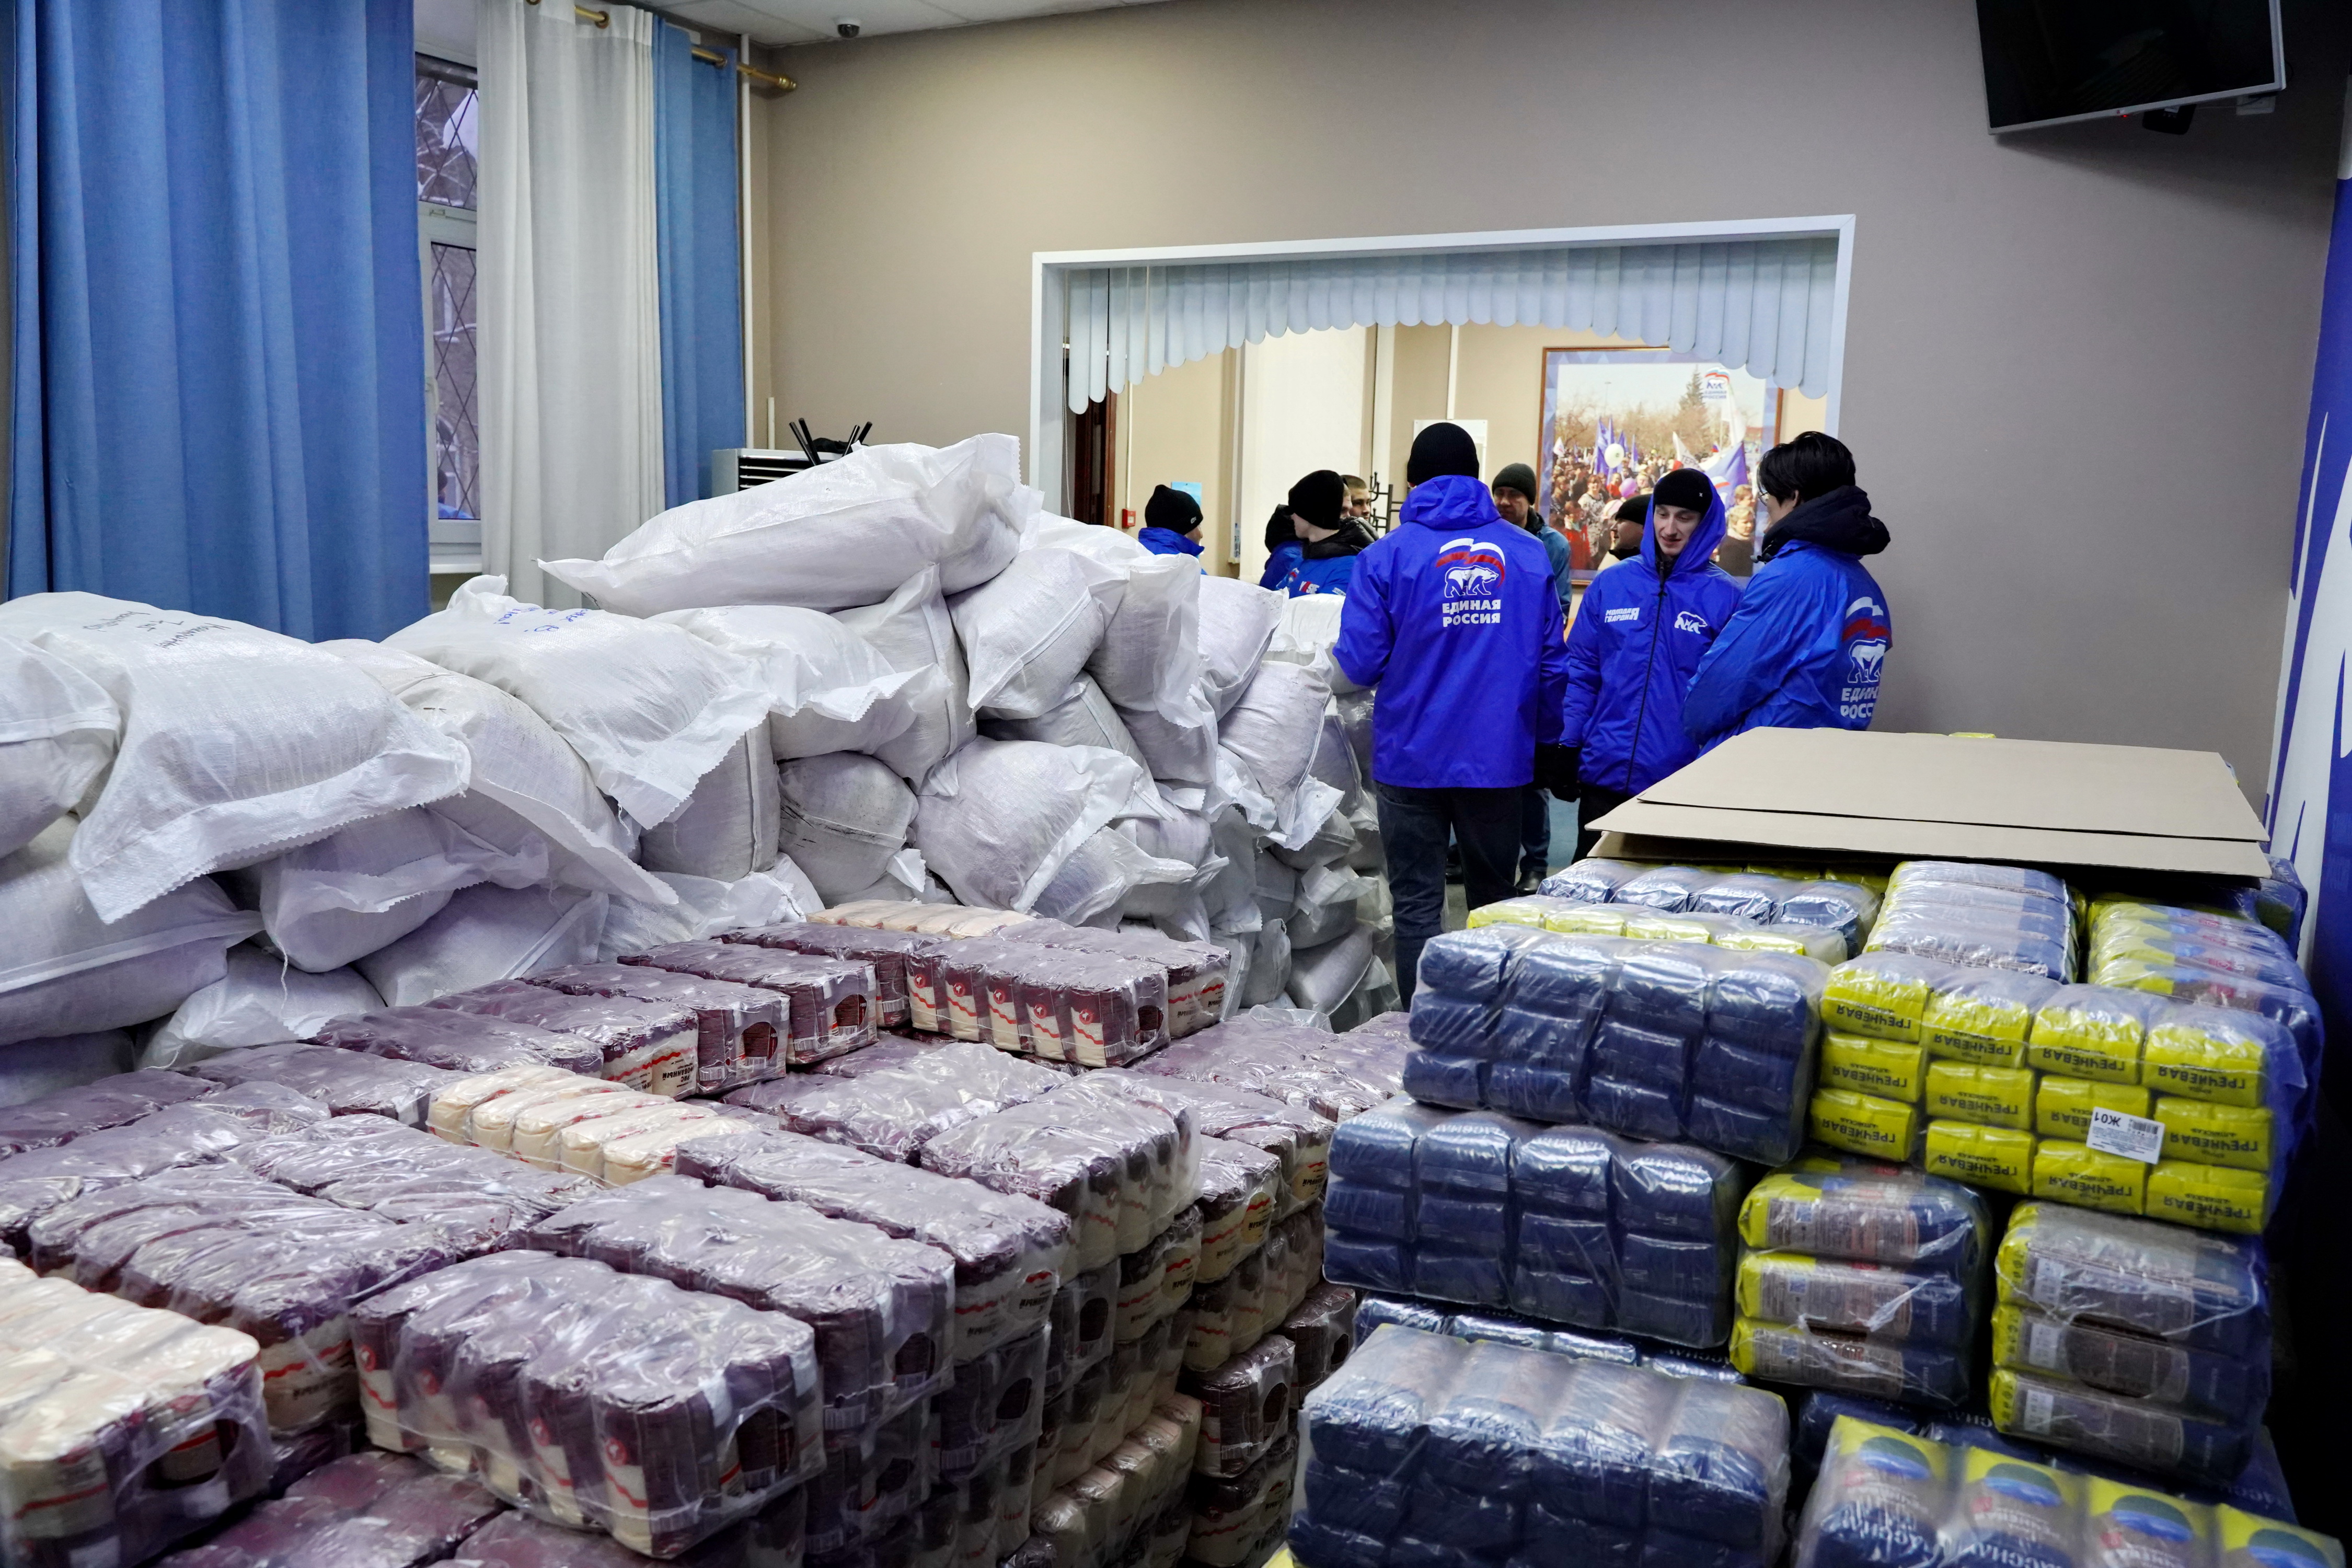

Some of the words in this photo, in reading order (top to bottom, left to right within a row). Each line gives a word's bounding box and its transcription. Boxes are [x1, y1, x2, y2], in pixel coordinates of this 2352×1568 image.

[1443, 599, 1501, 615] ЕДИНАЯ
[1606, 607, 1640, 617] МОЛОДАЯ
[1443, 613, 1501, 627] РОССИЯ
[1605, 613, 1640, 623] ГВАРДИЯ
[1841, 687, 1878, 702] ЕДИН
[1840, 702, 1874, 719] РОСС
[1836, 1005, 1911, 1029] ГРЕЧНЕВАЯ
[1934, 1034, 2012, 1056] ГРЕЧНЕВАЯ
[2043, 1048, 2125, 1071] ГРЕЧНЕВАЯ
[662, 1066, 694, 1081] ФОВАННЫЙ
[1832, 1066, 1908, 1088] ГРЕЧНЕВАЯ
[2158, 1067, 2245, 1089] ГРЕЧНЕВАЯ
[1940, 1096, 2018, 1114] ГРЕЧНЕВАЯ
[2094, 1111, 2121, 1128] Ж01
[1820, 1119, 1895, 1143] ГРЕЧНЕВАЯ
[2170, 1133, 2258, 1151] ГРЕЧНЕВАЯ
[1938, 1155, 2018, 1178] ГРЕЧНЕВАЯ
[2048, 1176, 2132, 1196] ГРЕЧНЕВАЯ
[2163, 1196, 2251, 1219] ГРЕЧНЕВАЯ
